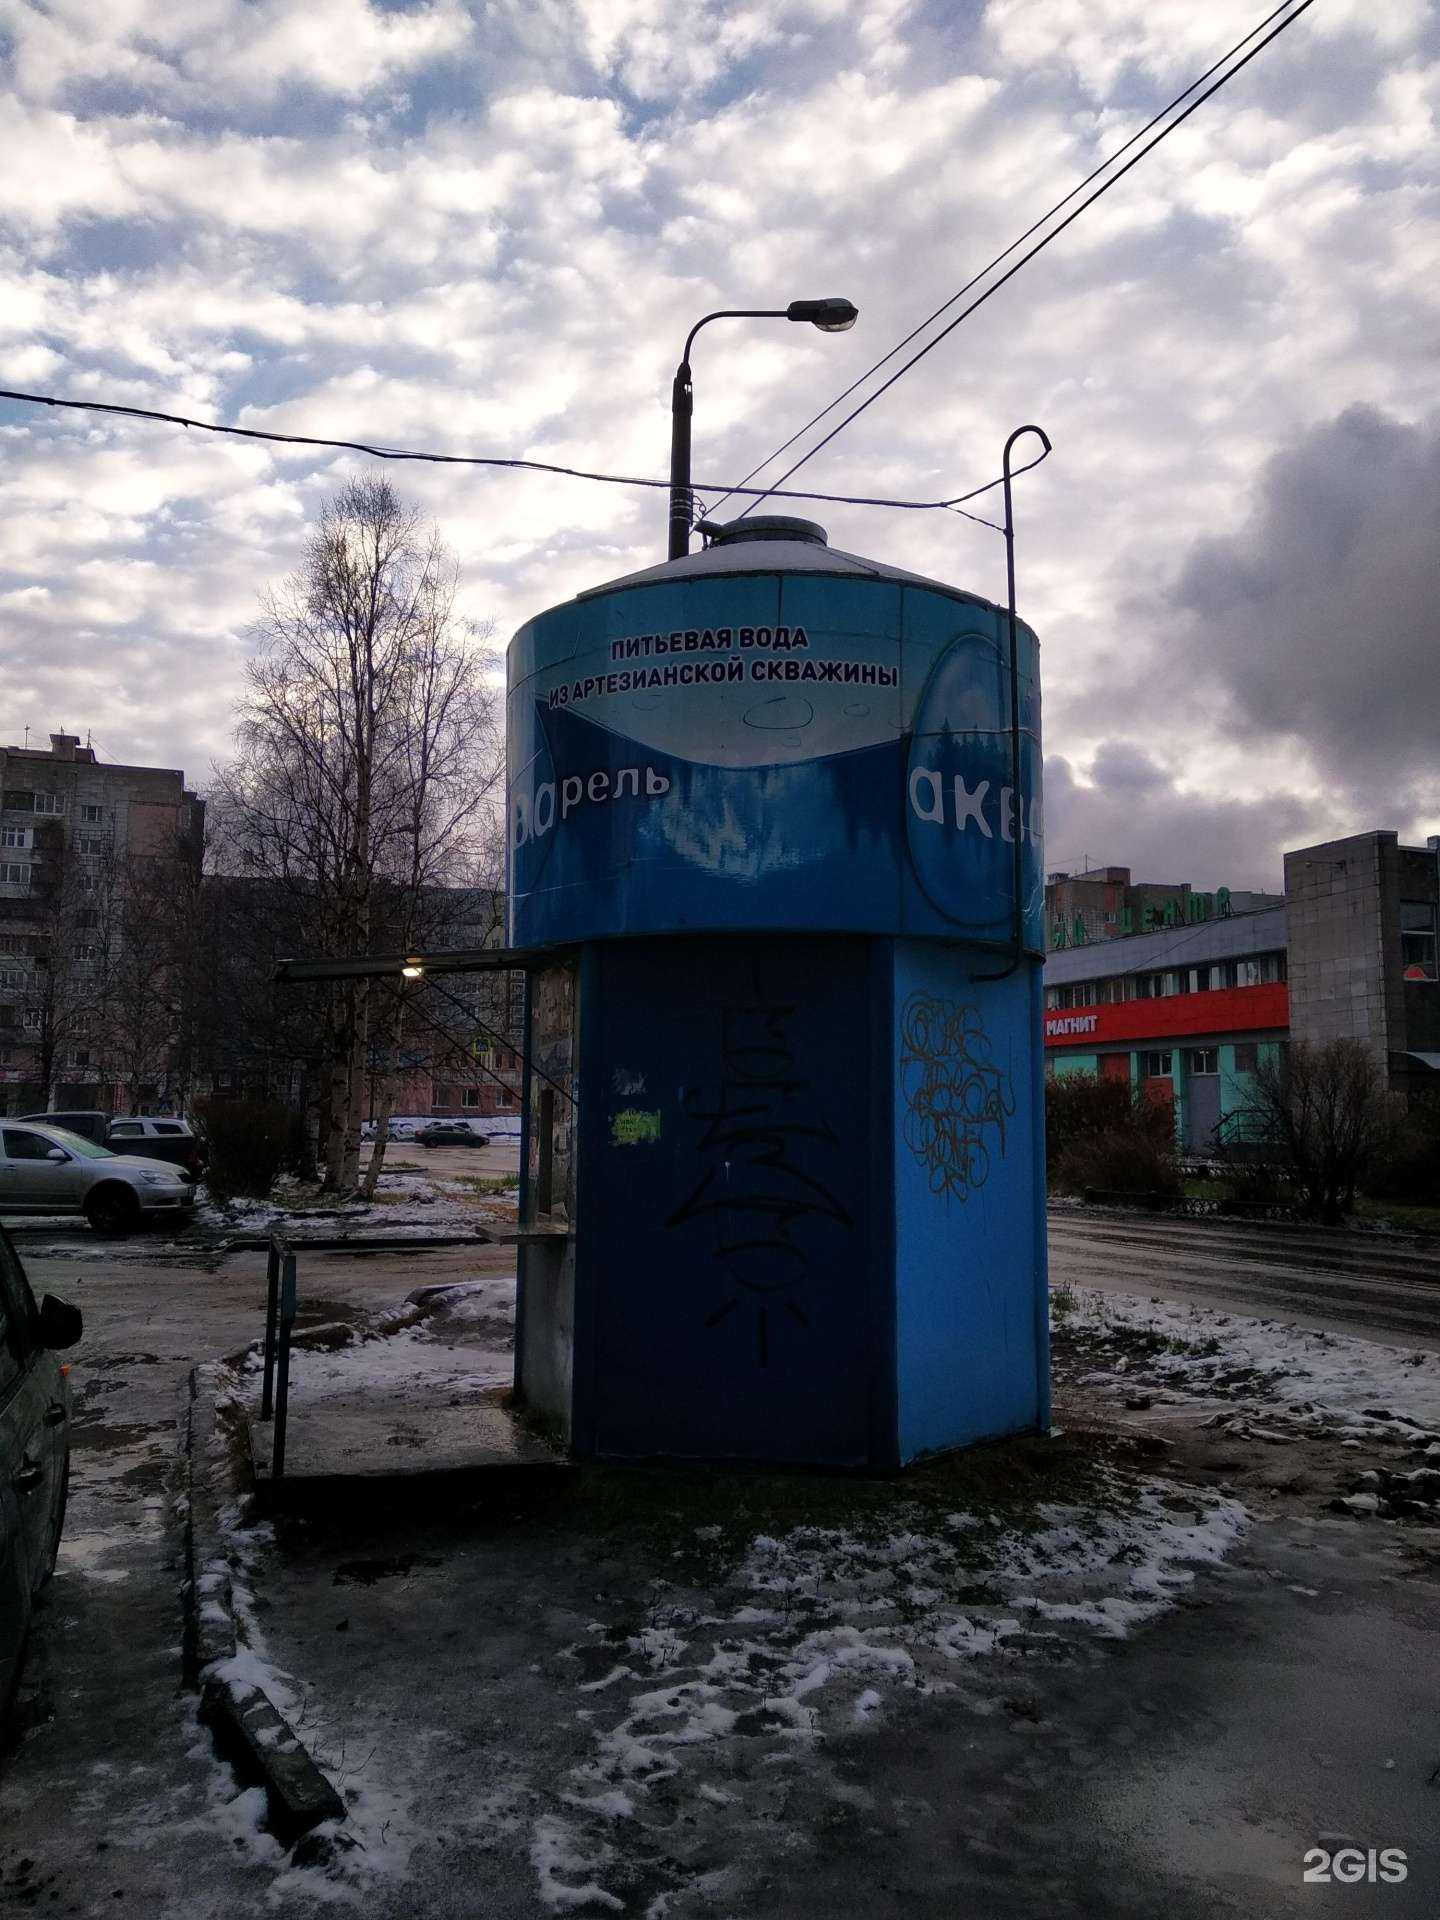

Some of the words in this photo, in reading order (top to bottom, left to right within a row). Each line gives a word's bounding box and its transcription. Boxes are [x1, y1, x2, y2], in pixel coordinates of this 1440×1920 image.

[611, 627, 733, 661] ПИТЬЕВАЯ
[738, 626, 810, 653] ВОДА
[548, 688, 569, 711] ИЗ
[571, 655, 744, 702] АРТЕЗИАНСКОЙ
[750, 659, 899, 688] СКВАЖИНЫ
[1046, 1015, 1098, 1036] МАГНИТ
